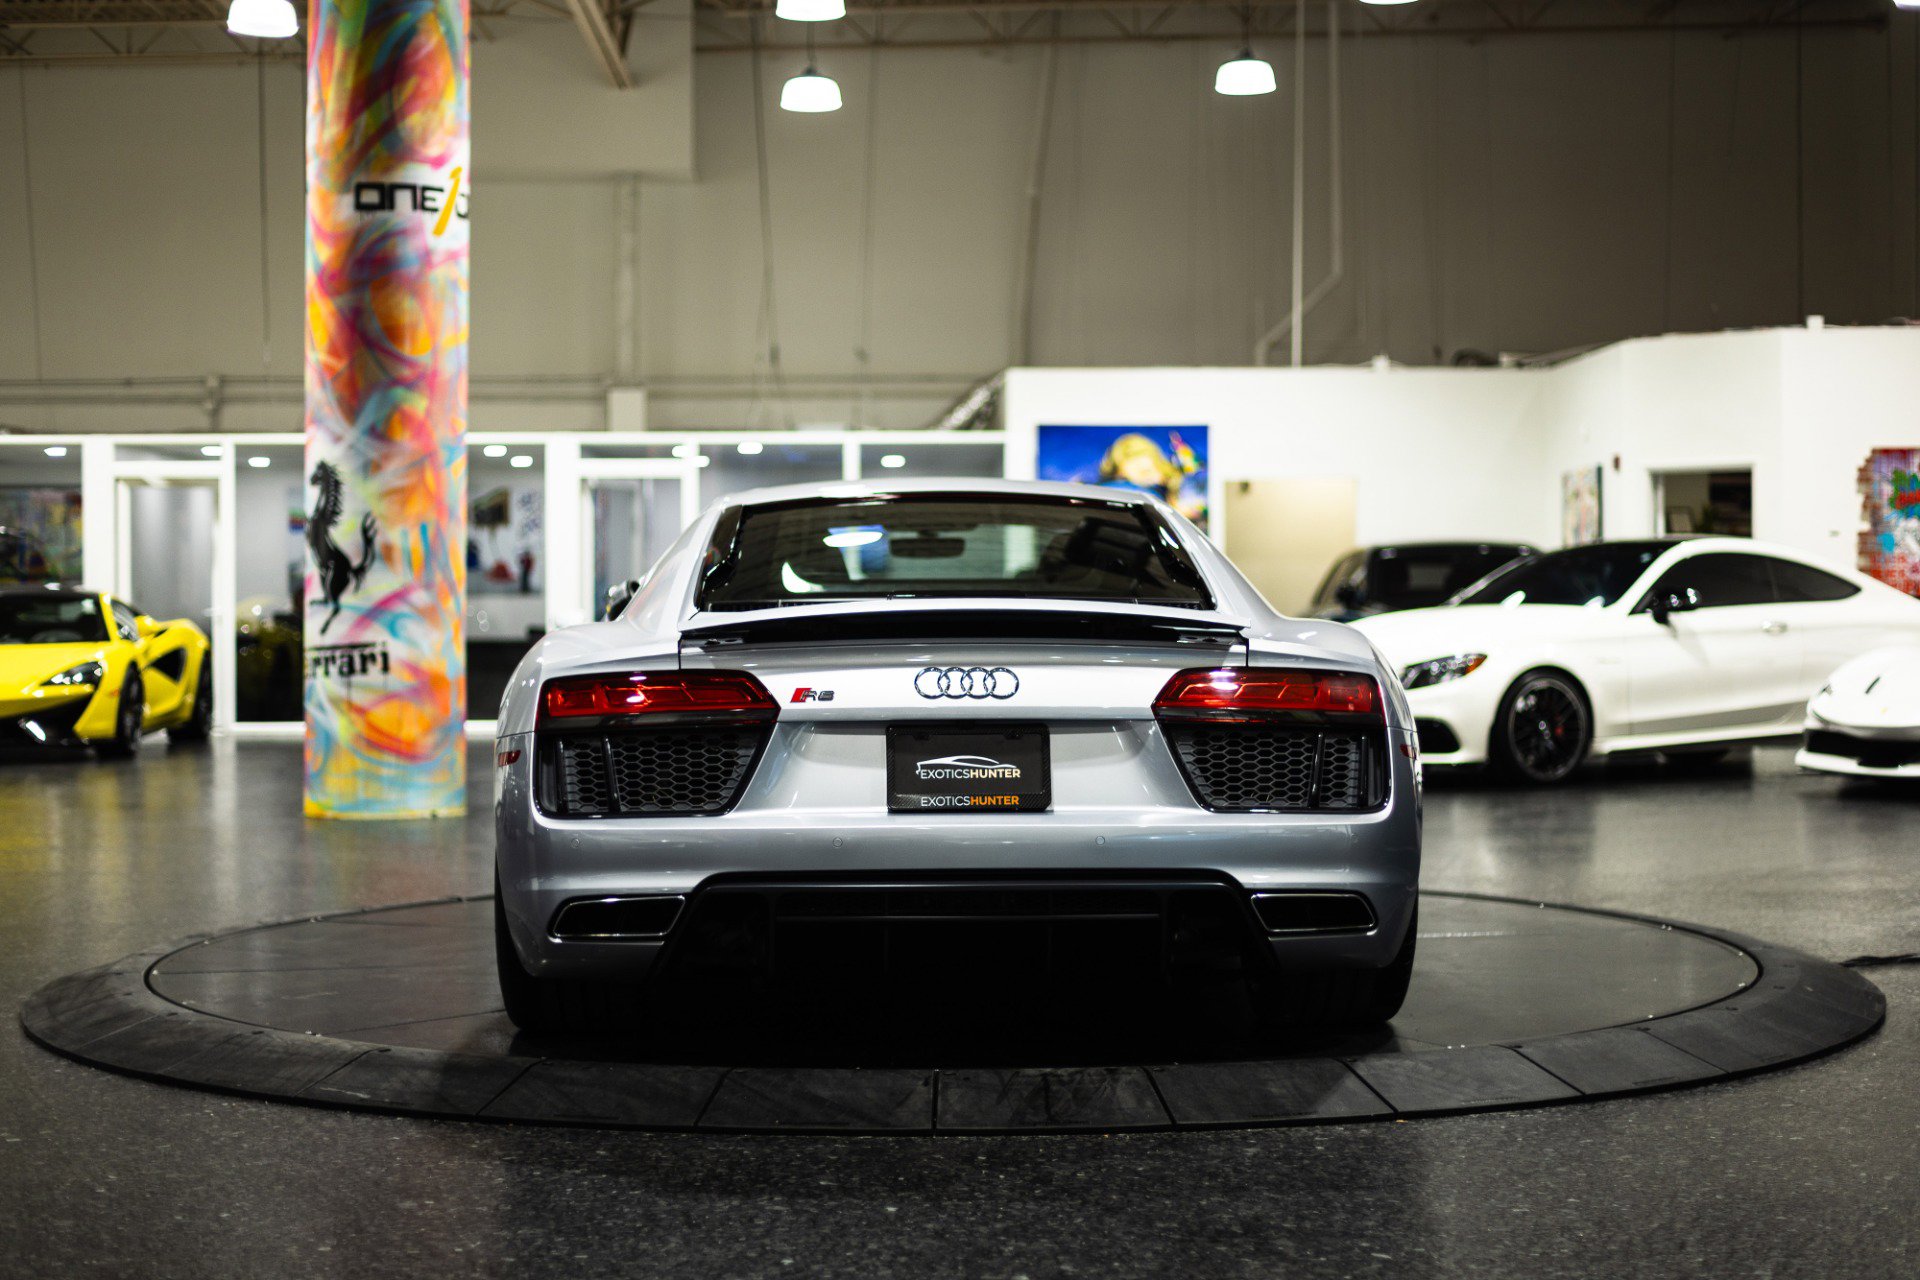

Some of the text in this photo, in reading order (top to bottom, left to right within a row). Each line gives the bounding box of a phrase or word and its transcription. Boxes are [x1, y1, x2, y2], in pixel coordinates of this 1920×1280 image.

[307, 643, 389, 678] rrari
[791, 687, 834, 703] R8
[920, 768, 1021, 779] EXOTICSHUNTER
[920, 795, 1020, 807] EXOTICSHUNTER
